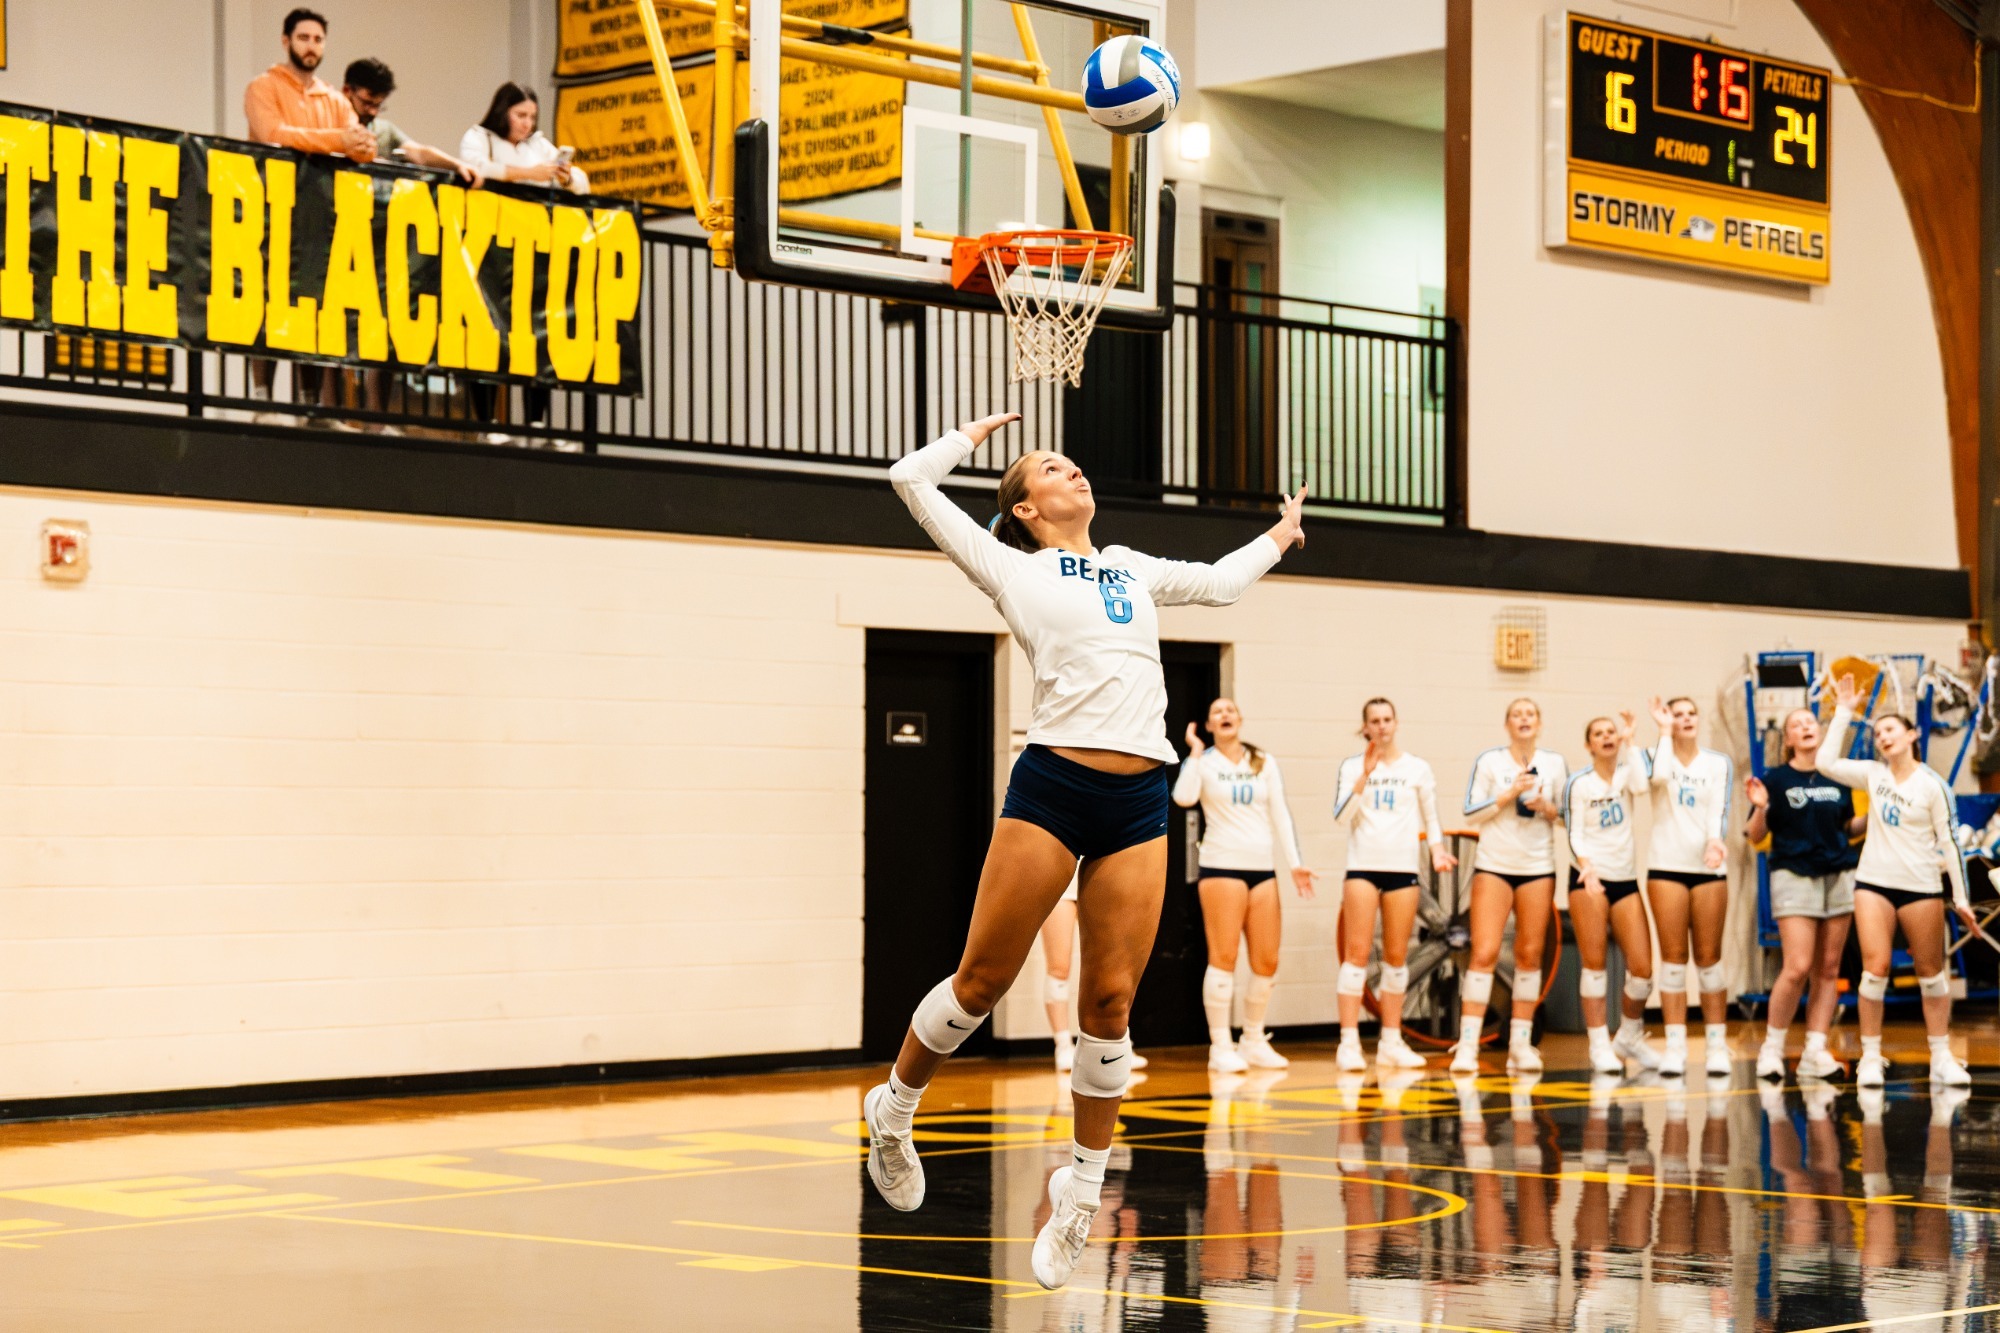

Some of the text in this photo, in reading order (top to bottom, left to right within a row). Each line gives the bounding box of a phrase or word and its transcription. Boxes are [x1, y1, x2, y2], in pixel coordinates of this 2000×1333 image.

[1578, 26, 1643, 61] GUEST
[1763, 67, 1822, 101] PETRELS
[795, 110, 848, 132] PALMER
[851, 98, 900, 123] AWARD
[1605, 71, 1636, 134] 16
[804, 133, 860, 156] DIVISION
[1655, 136, 1710, 166] PERIOD
[1774, 105, 1816, 169] 24
[1727, 139, 1736, 182] 1
[1573, 192, 1824, 260] STORMY PETRELS
[0, 115, 642, 385] THE BLACKTOP
[1098, 583, 1133, 624] 6
[1231, 784, 1254, 806] 10
[1374, 789, 1396, 811] 14
[1600, 803, 1624, 829] 20
[1881, 802, 1901, 827] 16
